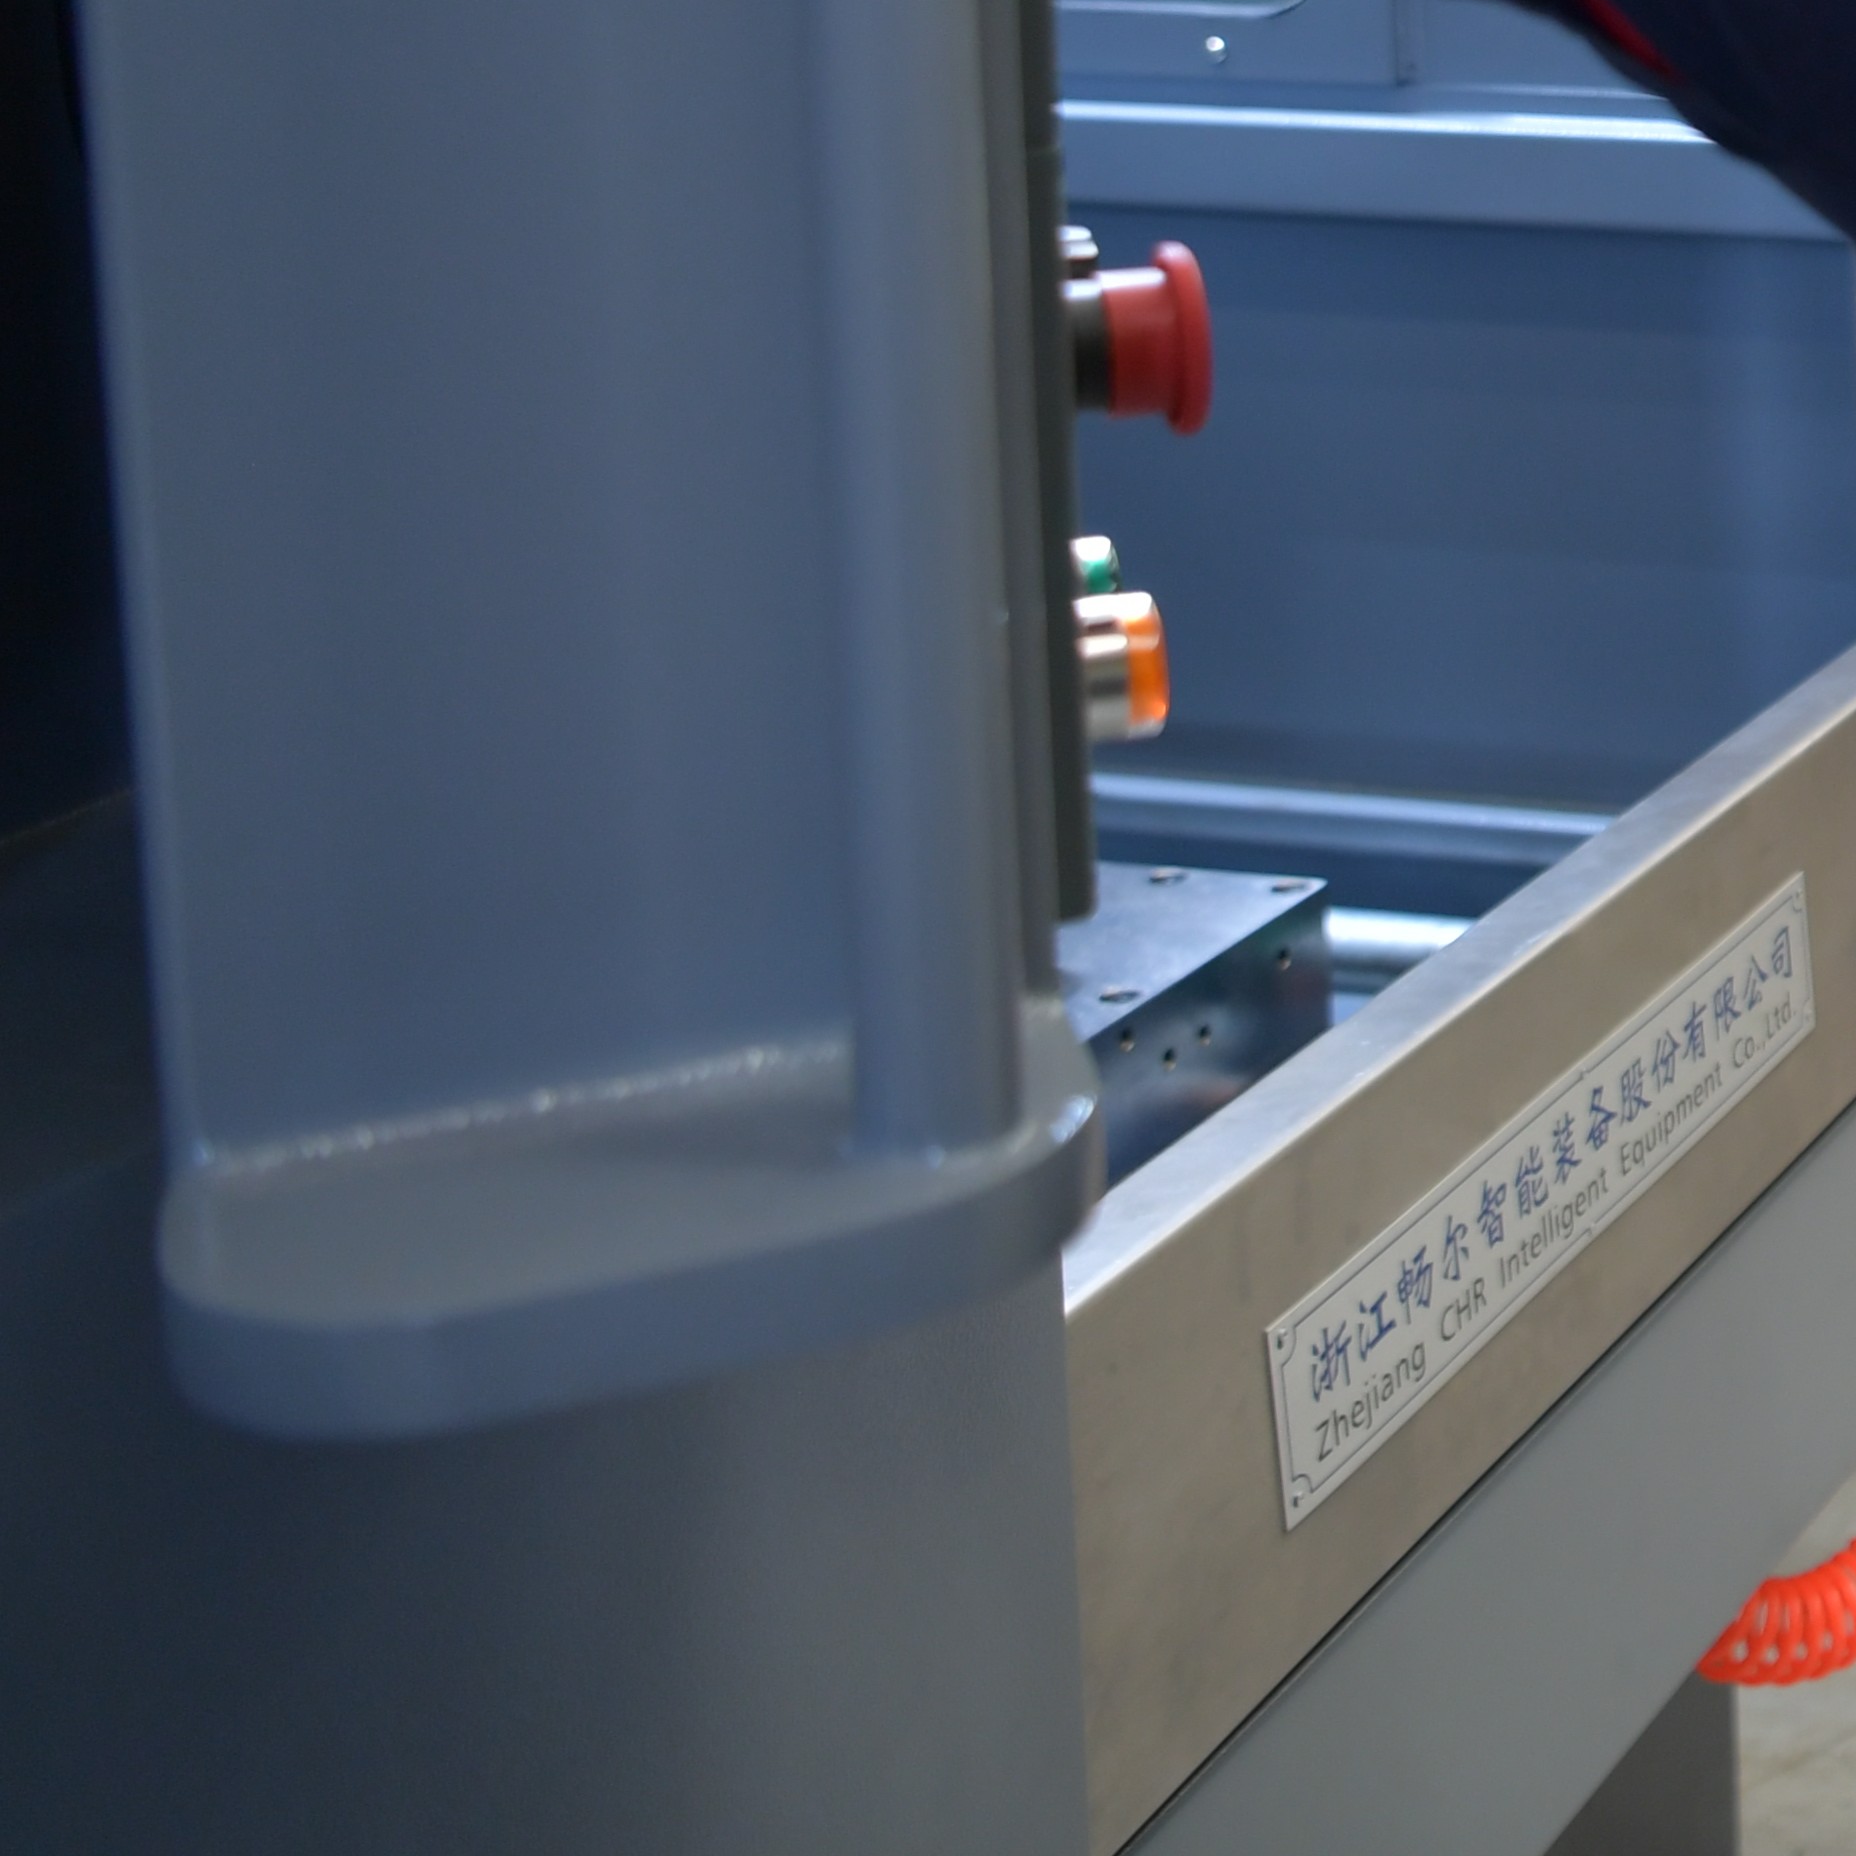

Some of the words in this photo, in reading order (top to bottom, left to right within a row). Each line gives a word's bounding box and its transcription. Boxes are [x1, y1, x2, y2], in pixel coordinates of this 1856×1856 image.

[1310, 925, 1794, 1403] 浙江畅尔智能装备股份有限公司
[1314, 1342, 1427, 1463] Zhejiang
[1439, 1276, 1489, 1343] CHR
[1499, 1168, 1610, 1290] Intelligent
[1619, 1061, 1724, 1177] Equipment
